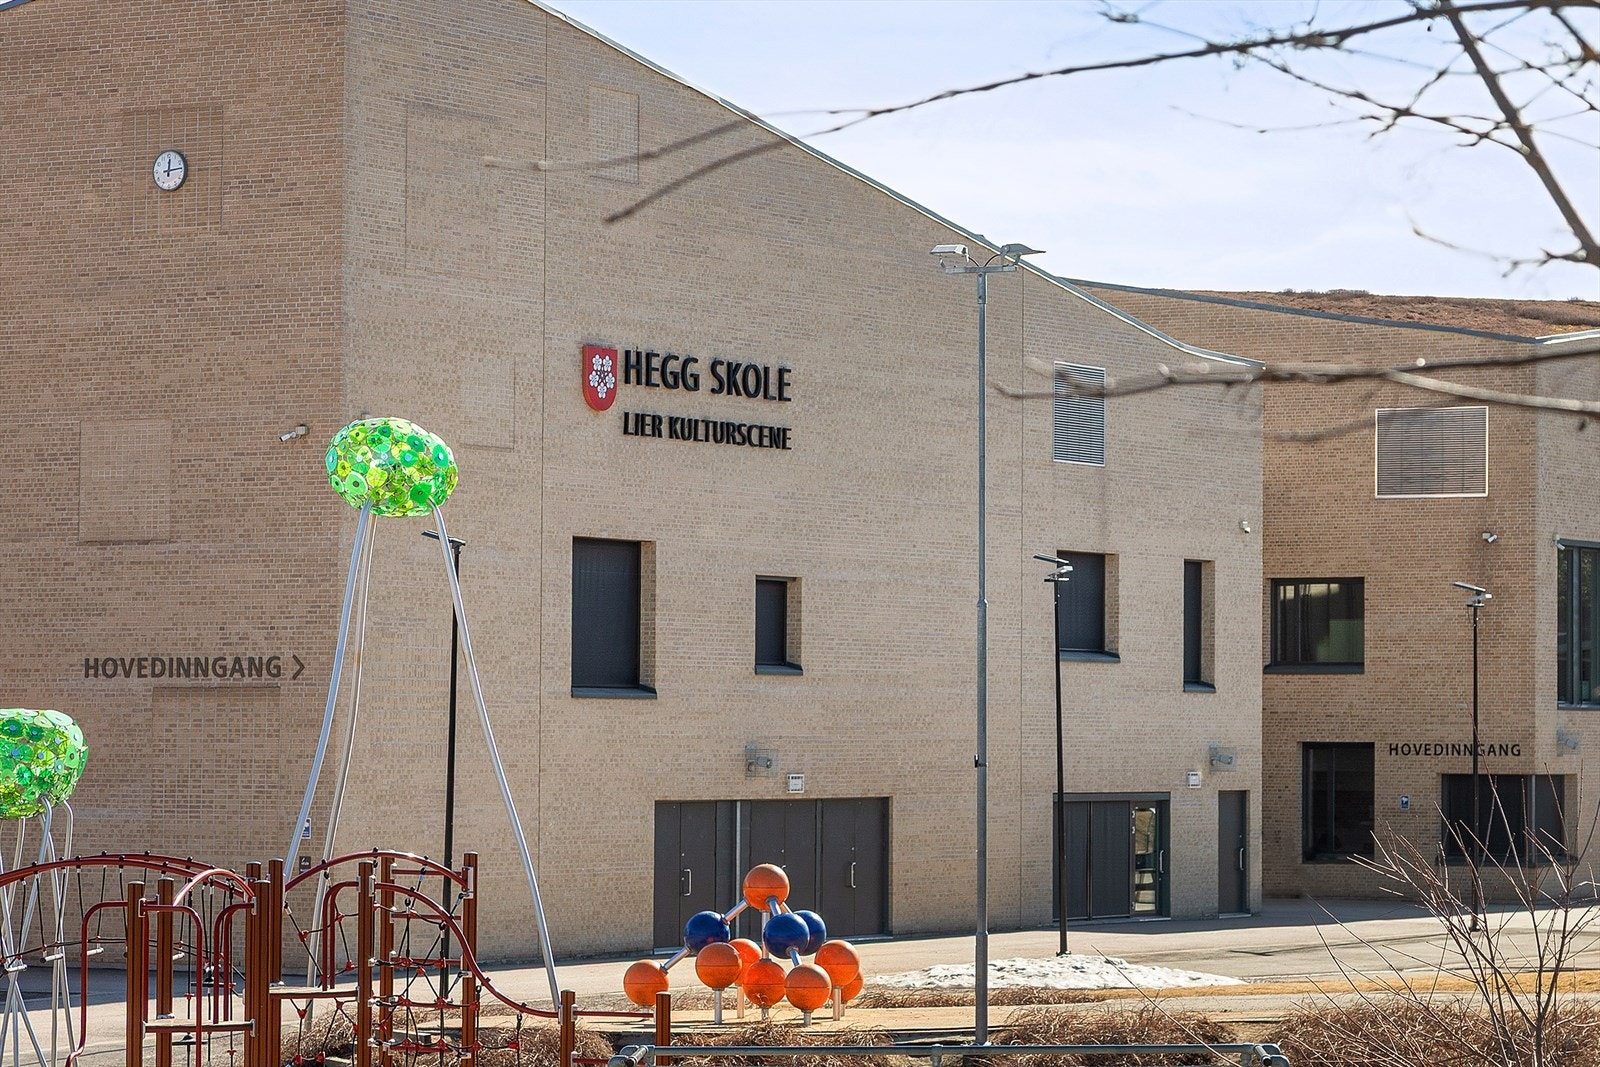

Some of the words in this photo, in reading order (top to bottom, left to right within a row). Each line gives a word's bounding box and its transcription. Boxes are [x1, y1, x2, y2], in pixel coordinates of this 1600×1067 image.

[624, 349, 700, 391] HEGG
[710, 359, 792, 401] SKOLE
[623, 411, 663, 438] LIER
[668, 415, 792, 450] KULTURSCENE
[84, 656, 282, 679] HOVEDINNGANG
[1389, 742, 1521, 757] HOVEDINNGANG
